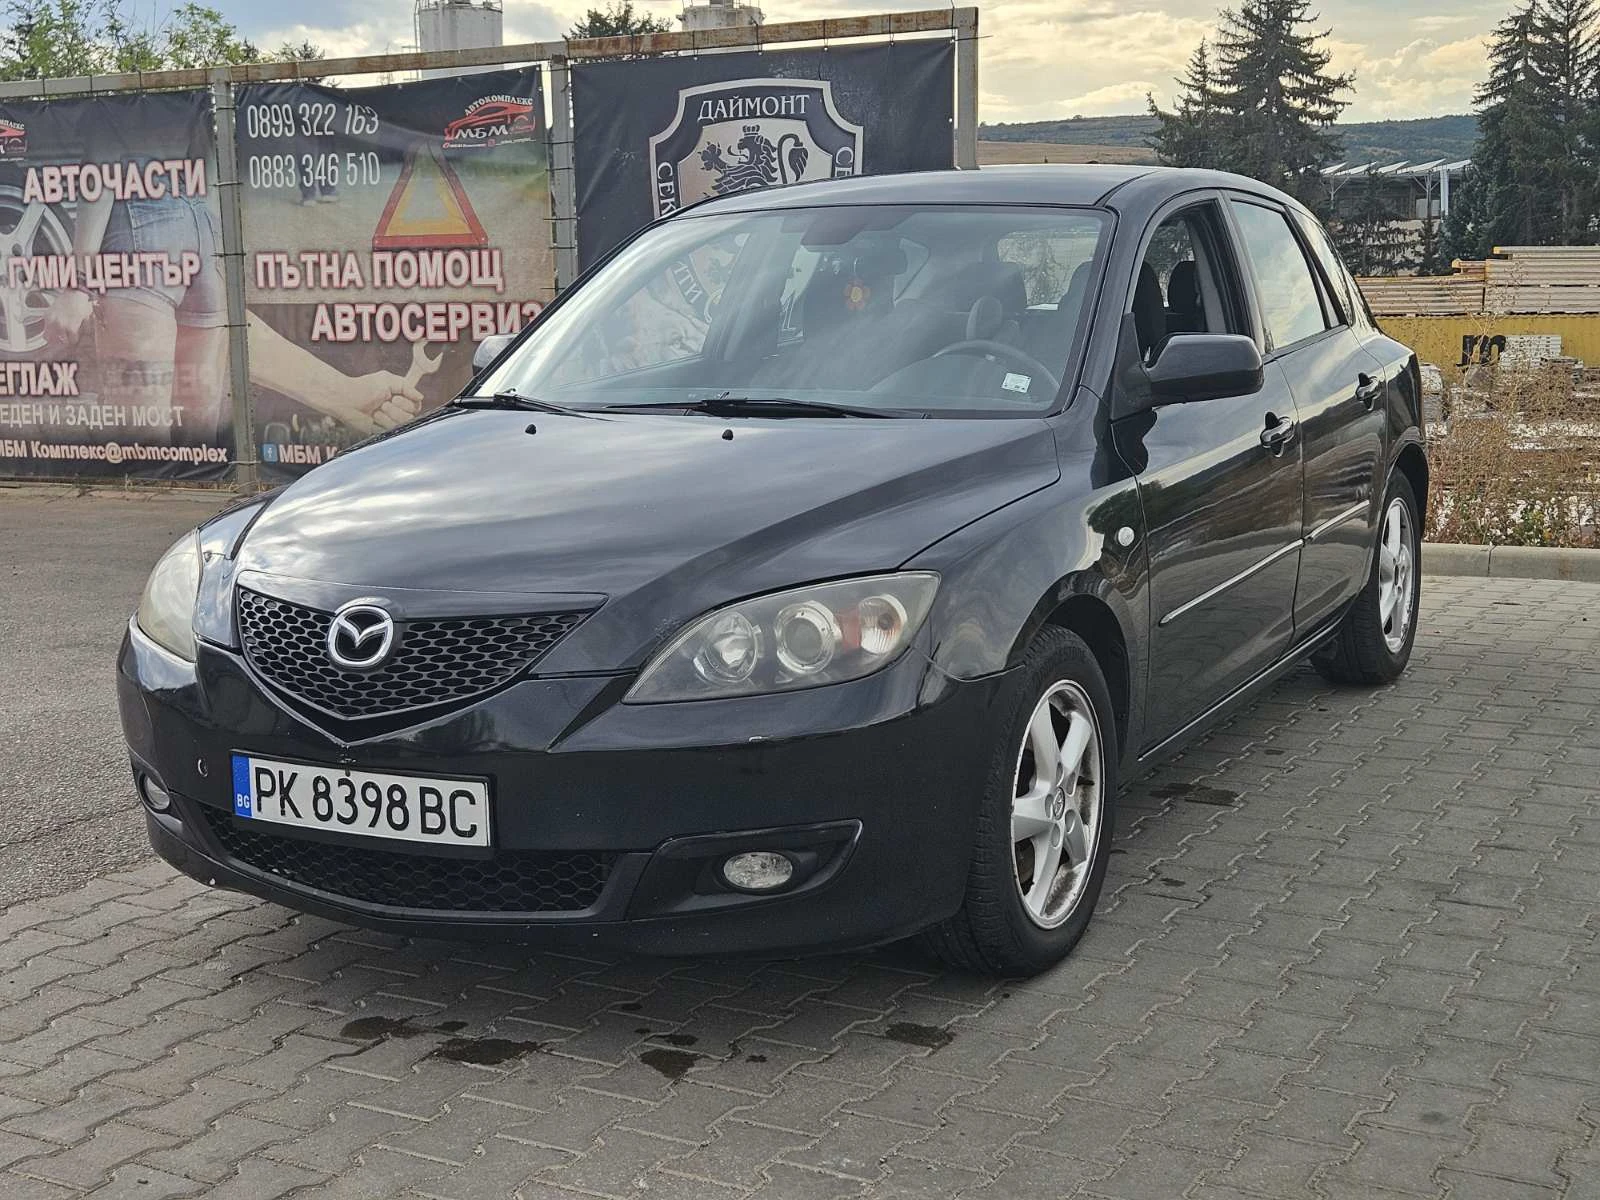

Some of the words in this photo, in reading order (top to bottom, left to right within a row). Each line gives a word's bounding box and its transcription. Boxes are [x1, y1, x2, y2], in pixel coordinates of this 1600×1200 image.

[247, 104, 296, 138] 0899
[300, 103, 335, 136] 322
[344, 103, 379, 134] 163
[464, 94, 533, 116] АВТОКОМПЛЕКС
[697, 94, 810, 121] ДАЙМОНТ
[24, 159, 206, 203] АВТОЧАСТИ
[250, 155, 296, 188] 0883
[301, 153, 339, 187] 346
[345, 152, 381, 186] 510
[8, 254, 78, 289] ГУМИ
[84, 252, 201, 294] ЦЕНТЪР
[256, 252, 364, 288] ПЪТНА
[373, 249, 504, 292] ПОМОЩ
[49, 404, 60, 425] И
[65, 404, 126, 430] ЗАДЕН
[132, 406, 184, 427] МОСТ
[279, 444, 321, 464] МБМ
[237, 793, 250, 809] BG
[312, 775, 410, 831] 8398
